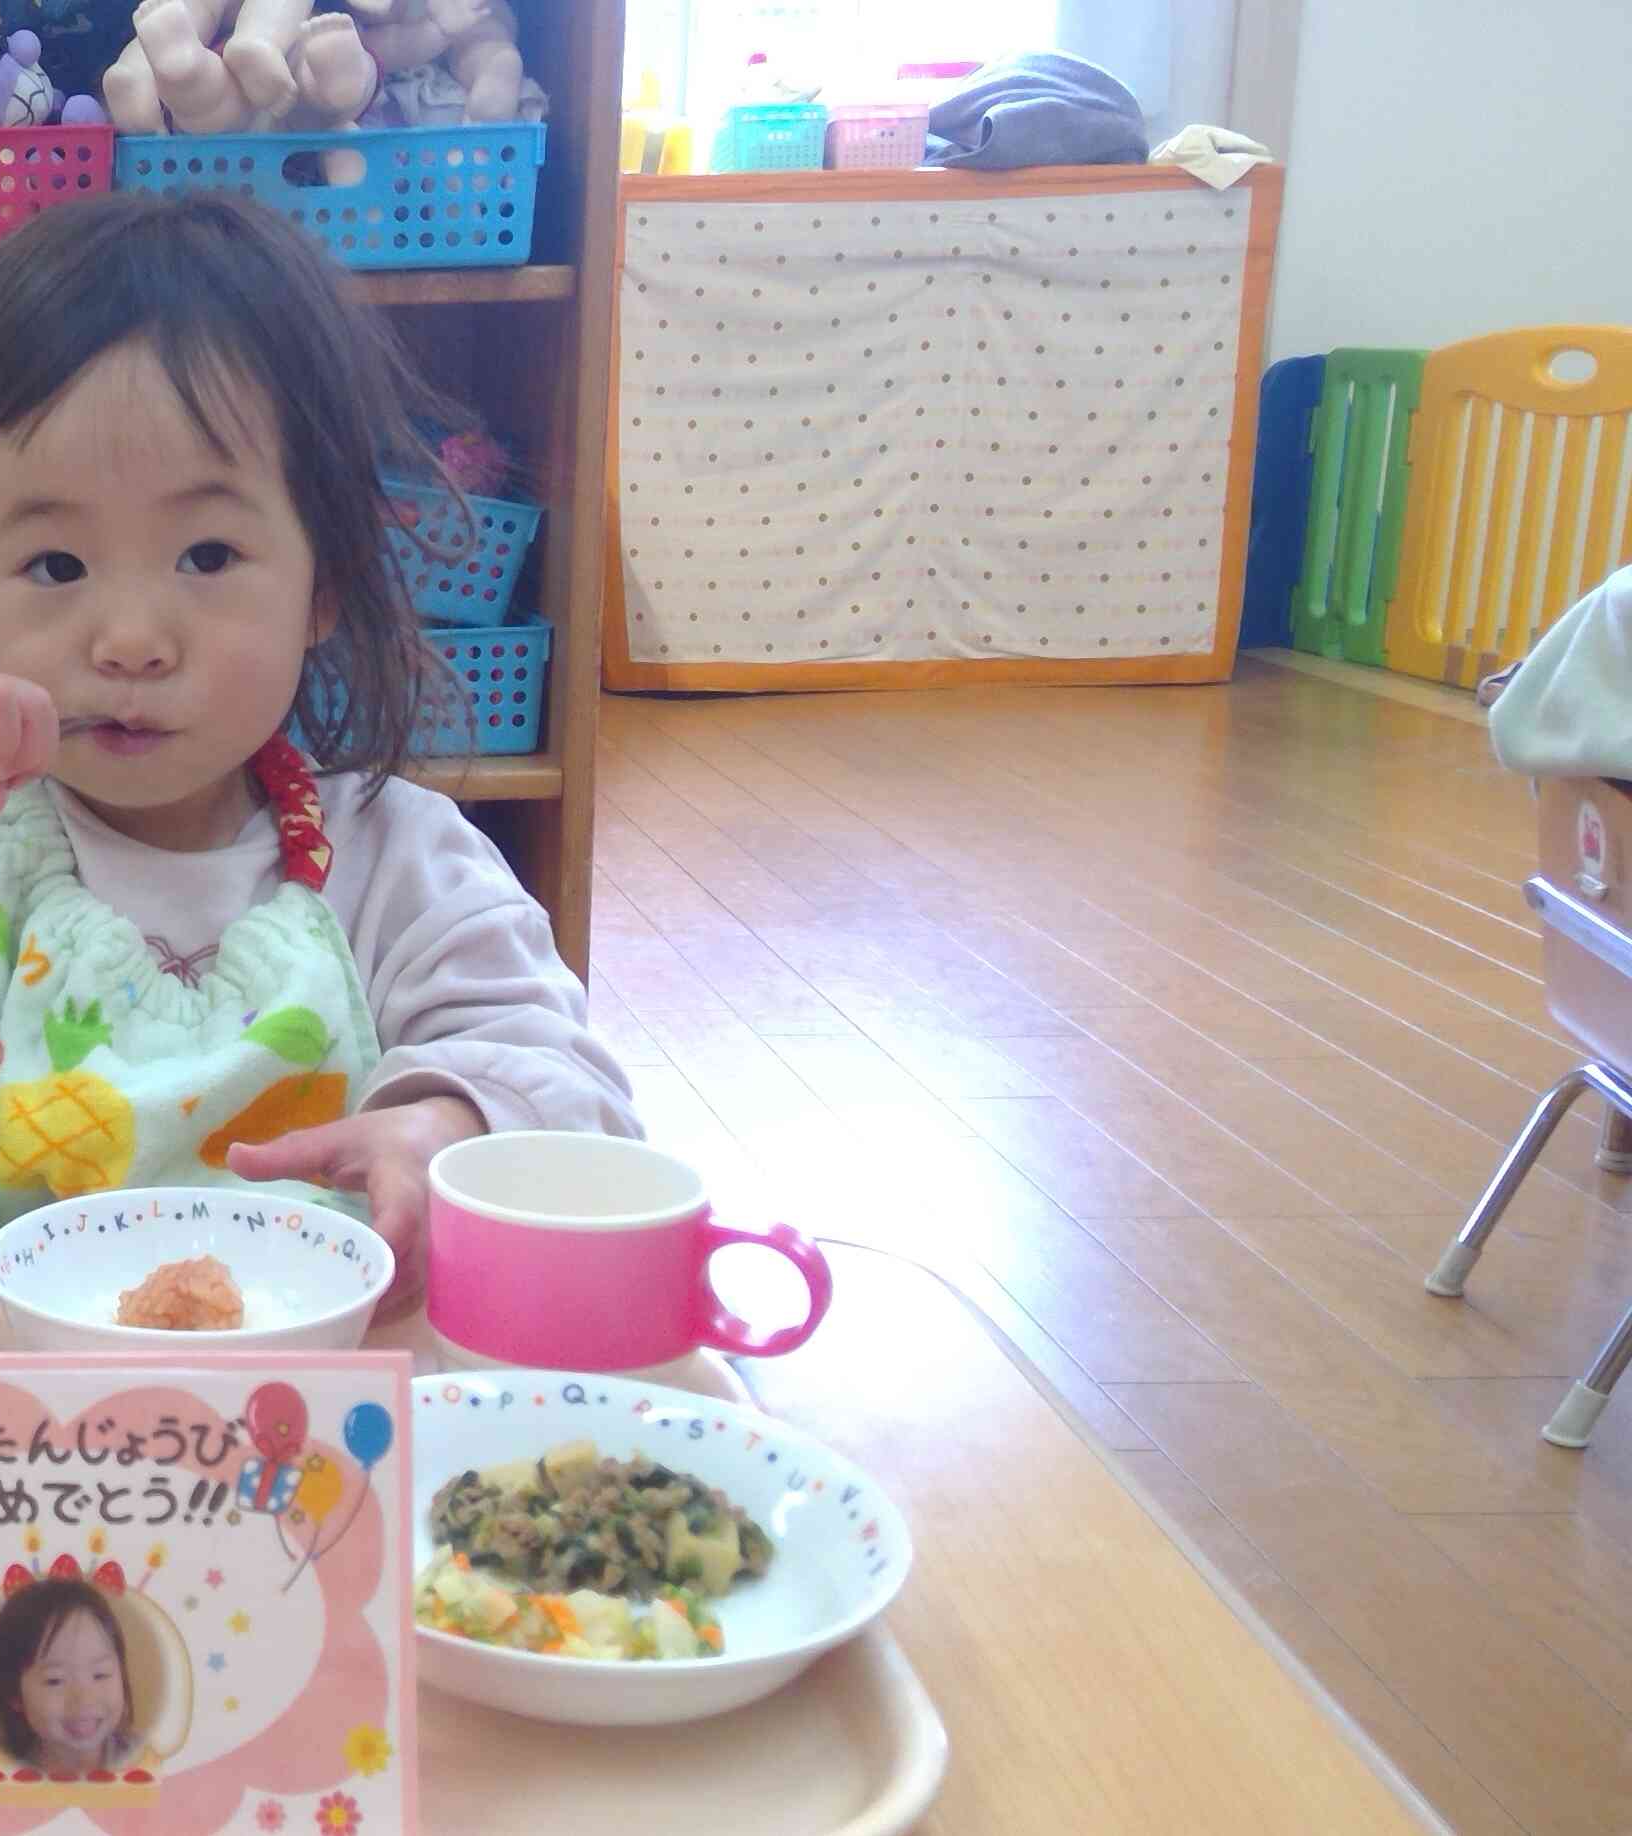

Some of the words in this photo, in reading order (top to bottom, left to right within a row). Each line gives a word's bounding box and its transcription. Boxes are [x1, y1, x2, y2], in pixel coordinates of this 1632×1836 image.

[43, 1223, 55, 1240] I
[77, 1214, 88, 1232] J
[114, 1212, 129, 1231] K
[154, 1200, 164, 1218] L
[192, 1201, 209, 1219] M
[247, 1211, 265, 1232] N
[286, 1213, 303, 1231] O
[443, 1384, 461, 1404] O
[562, 1383, 588, 1405] Q
[688, 1419, 704, 1440] S
